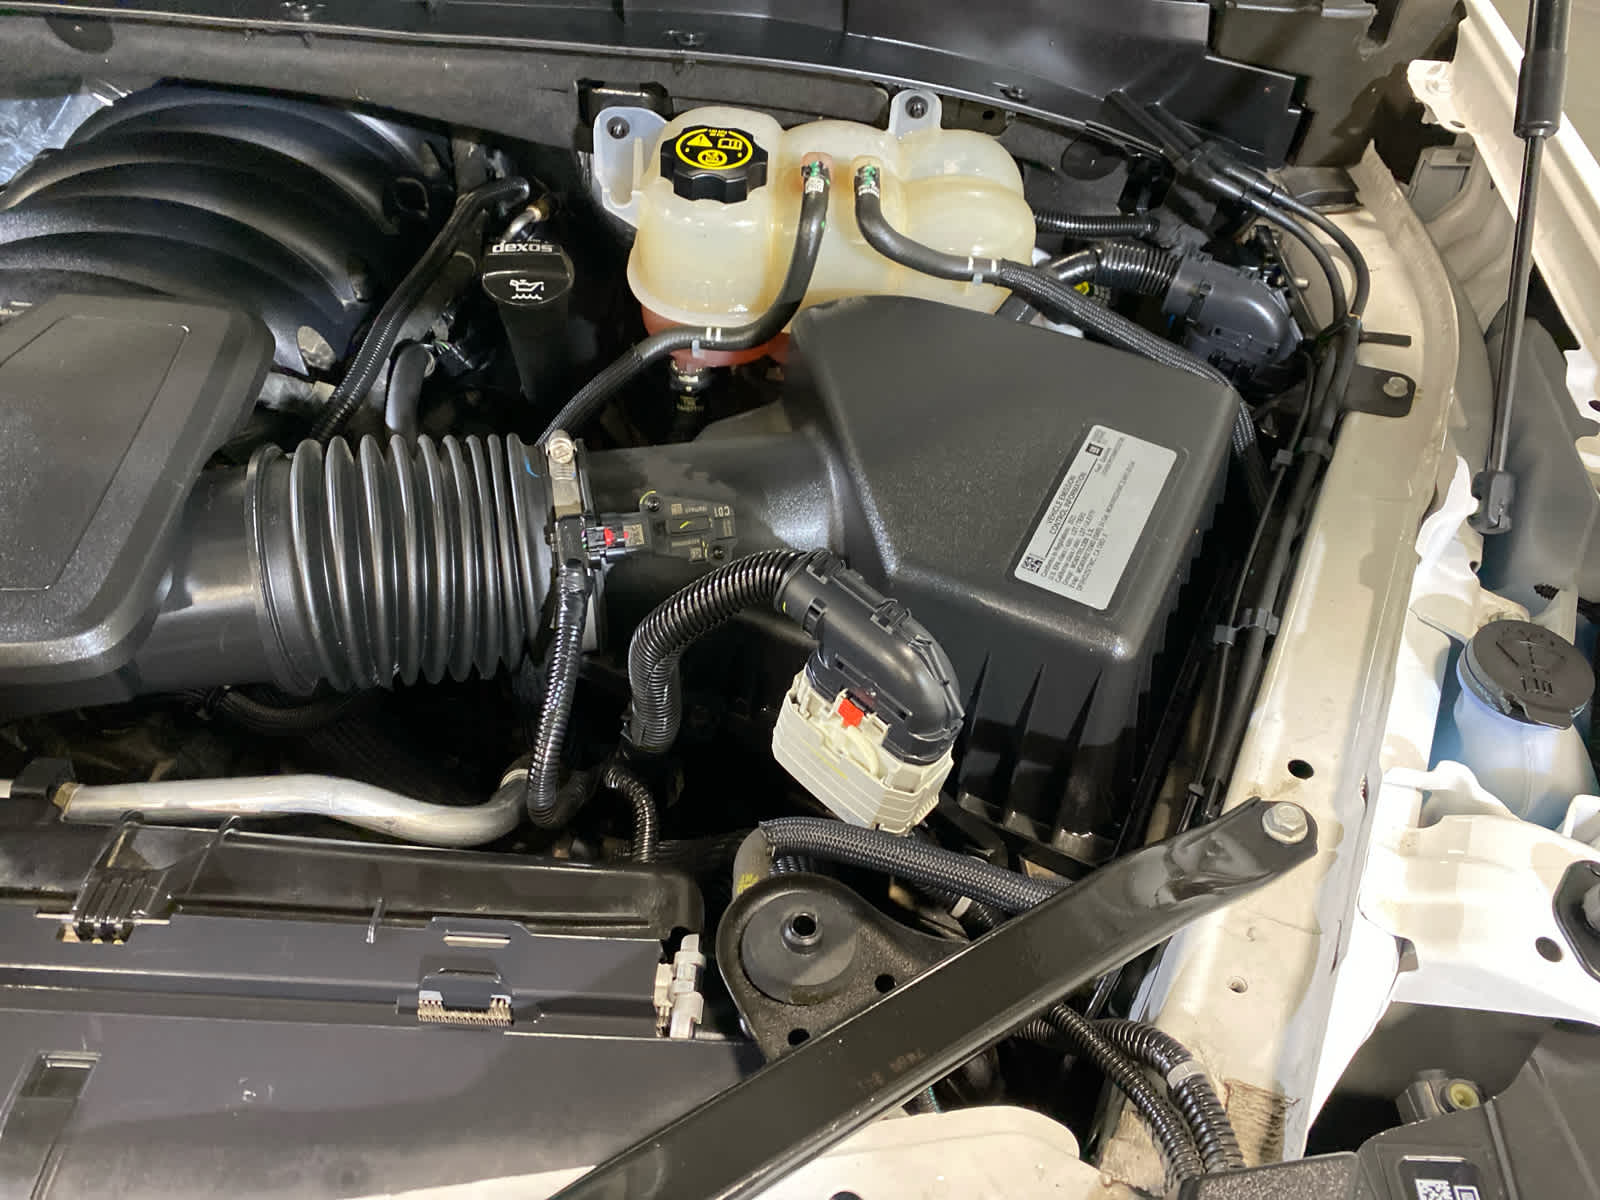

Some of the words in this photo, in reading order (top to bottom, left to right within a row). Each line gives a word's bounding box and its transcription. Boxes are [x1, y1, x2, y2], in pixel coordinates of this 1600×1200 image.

[492, 240, 553, 253] dexos
[1046, 500, 1063, 524] VEHICLE
[1059, 474, 1077, 501] EMISSION
[1050, 507, 1068, 534] CONTROL
[1064, 472, 1087, 507] INFORMATION
